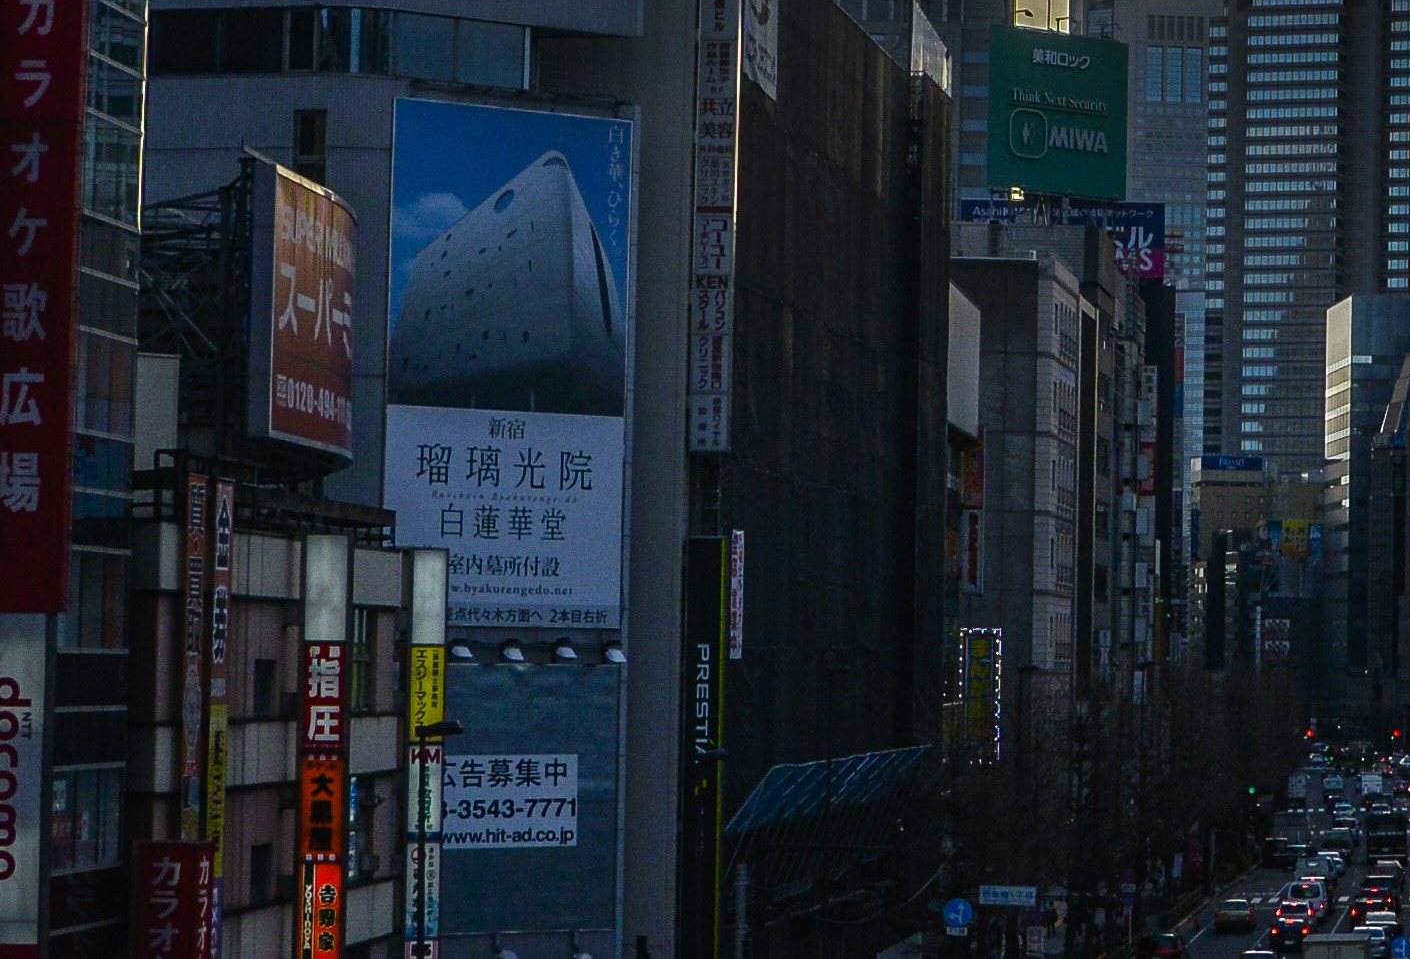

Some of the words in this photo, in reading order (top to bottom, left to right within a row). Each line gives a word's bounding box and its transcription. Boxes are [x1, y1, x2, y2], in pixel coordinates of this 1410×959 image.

[1032, 48, 1090, 69] 美和ロック
[1011, 87, 1041, 104] Think
[1043, 92, 1067, 108] Next
[1068, 95, 1108, 113] Security
[1048, 125, 1109, 154] MIWA
[696, 274, 729, 289] KEN
[488, 417, 526, 440] 新宿
[416, 443, 593, 491] 瑠璃光院
[440, 503, 567, 541] 白蓮華堂
[307, 658, 341, 741] 指圧
[22, 712, 32, 739] NTT
[149, 855, 182, 959] カラオ
